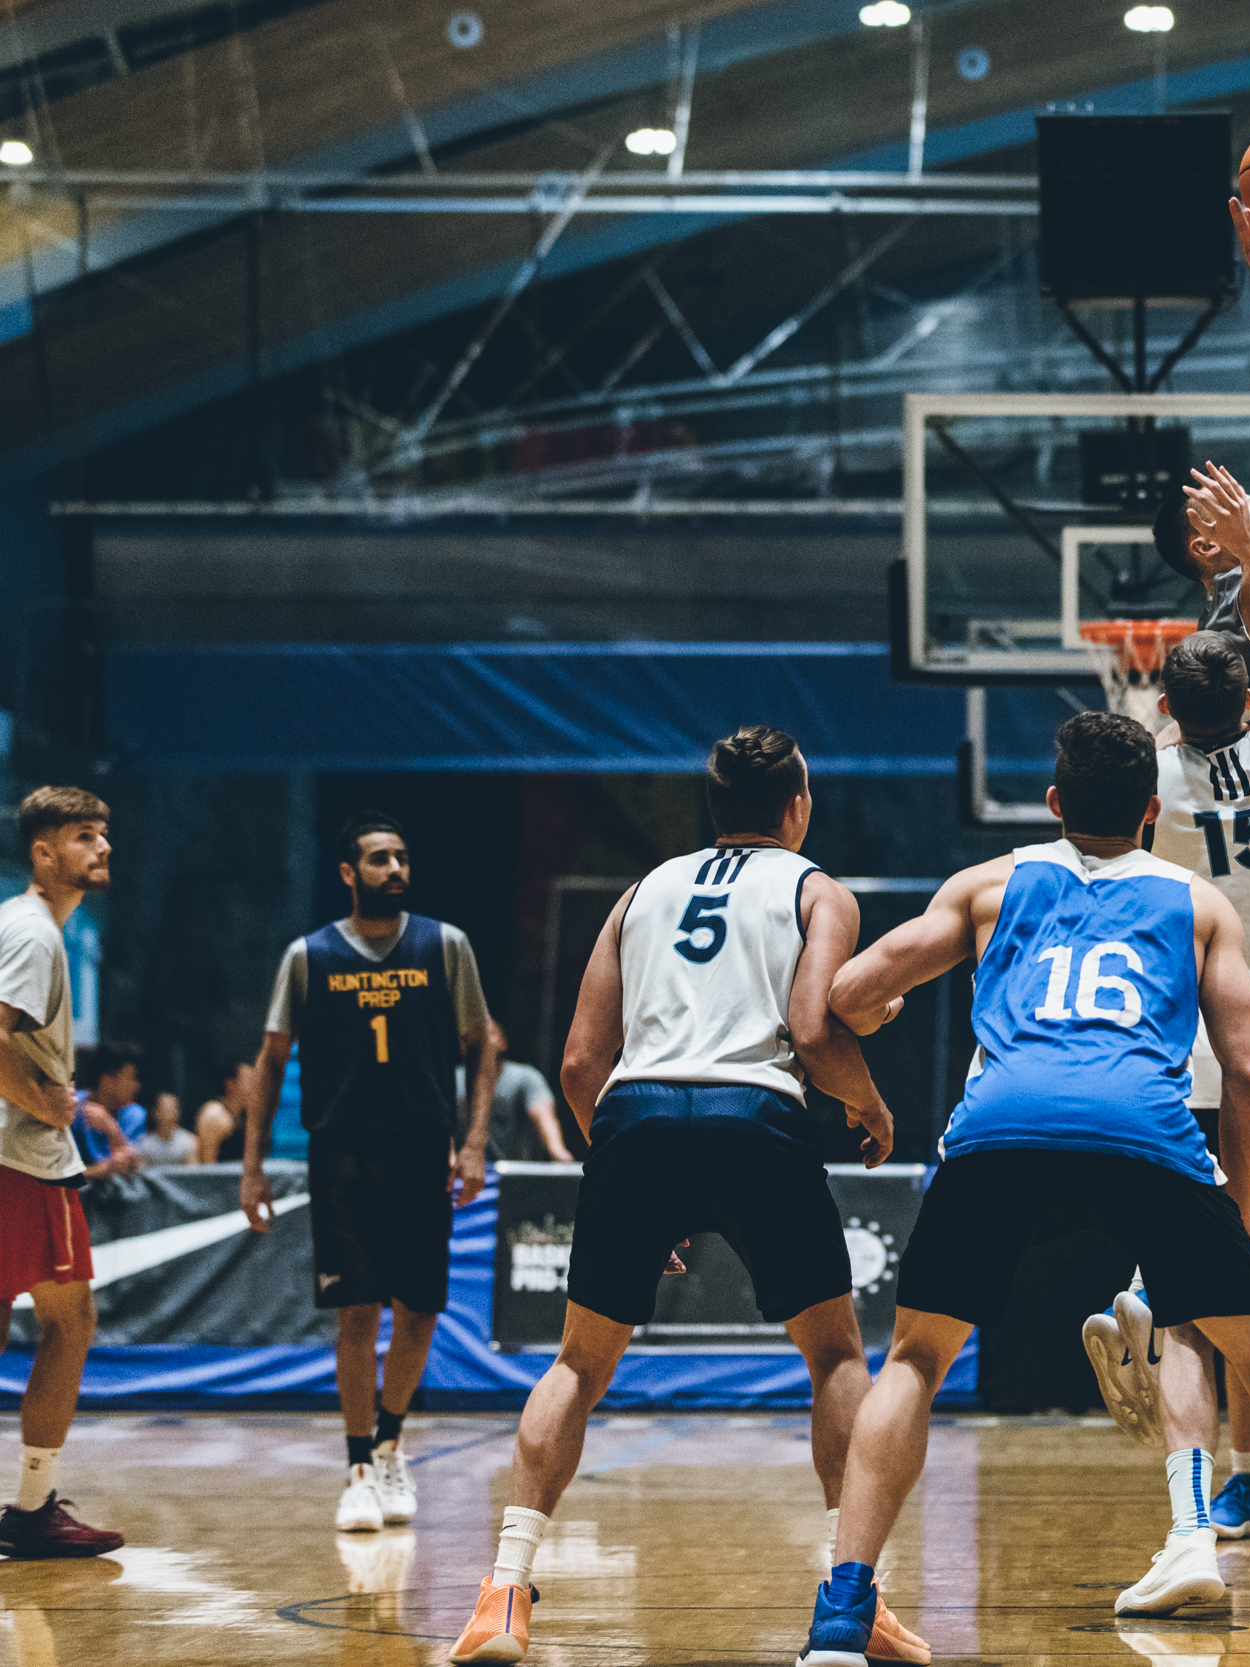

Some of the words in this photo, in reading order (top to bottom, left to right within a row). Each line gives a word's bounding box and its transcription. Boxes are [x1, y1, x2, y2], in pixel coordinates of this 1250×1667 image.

[673, 892, 730, 965] 5
[327, 968, 429, 993] HUNTINGTON
[357, 989, 402, 1009] PREP
[1033, 940, 1145, 1029] 16
[369, 1013, 390, 1064] 1
